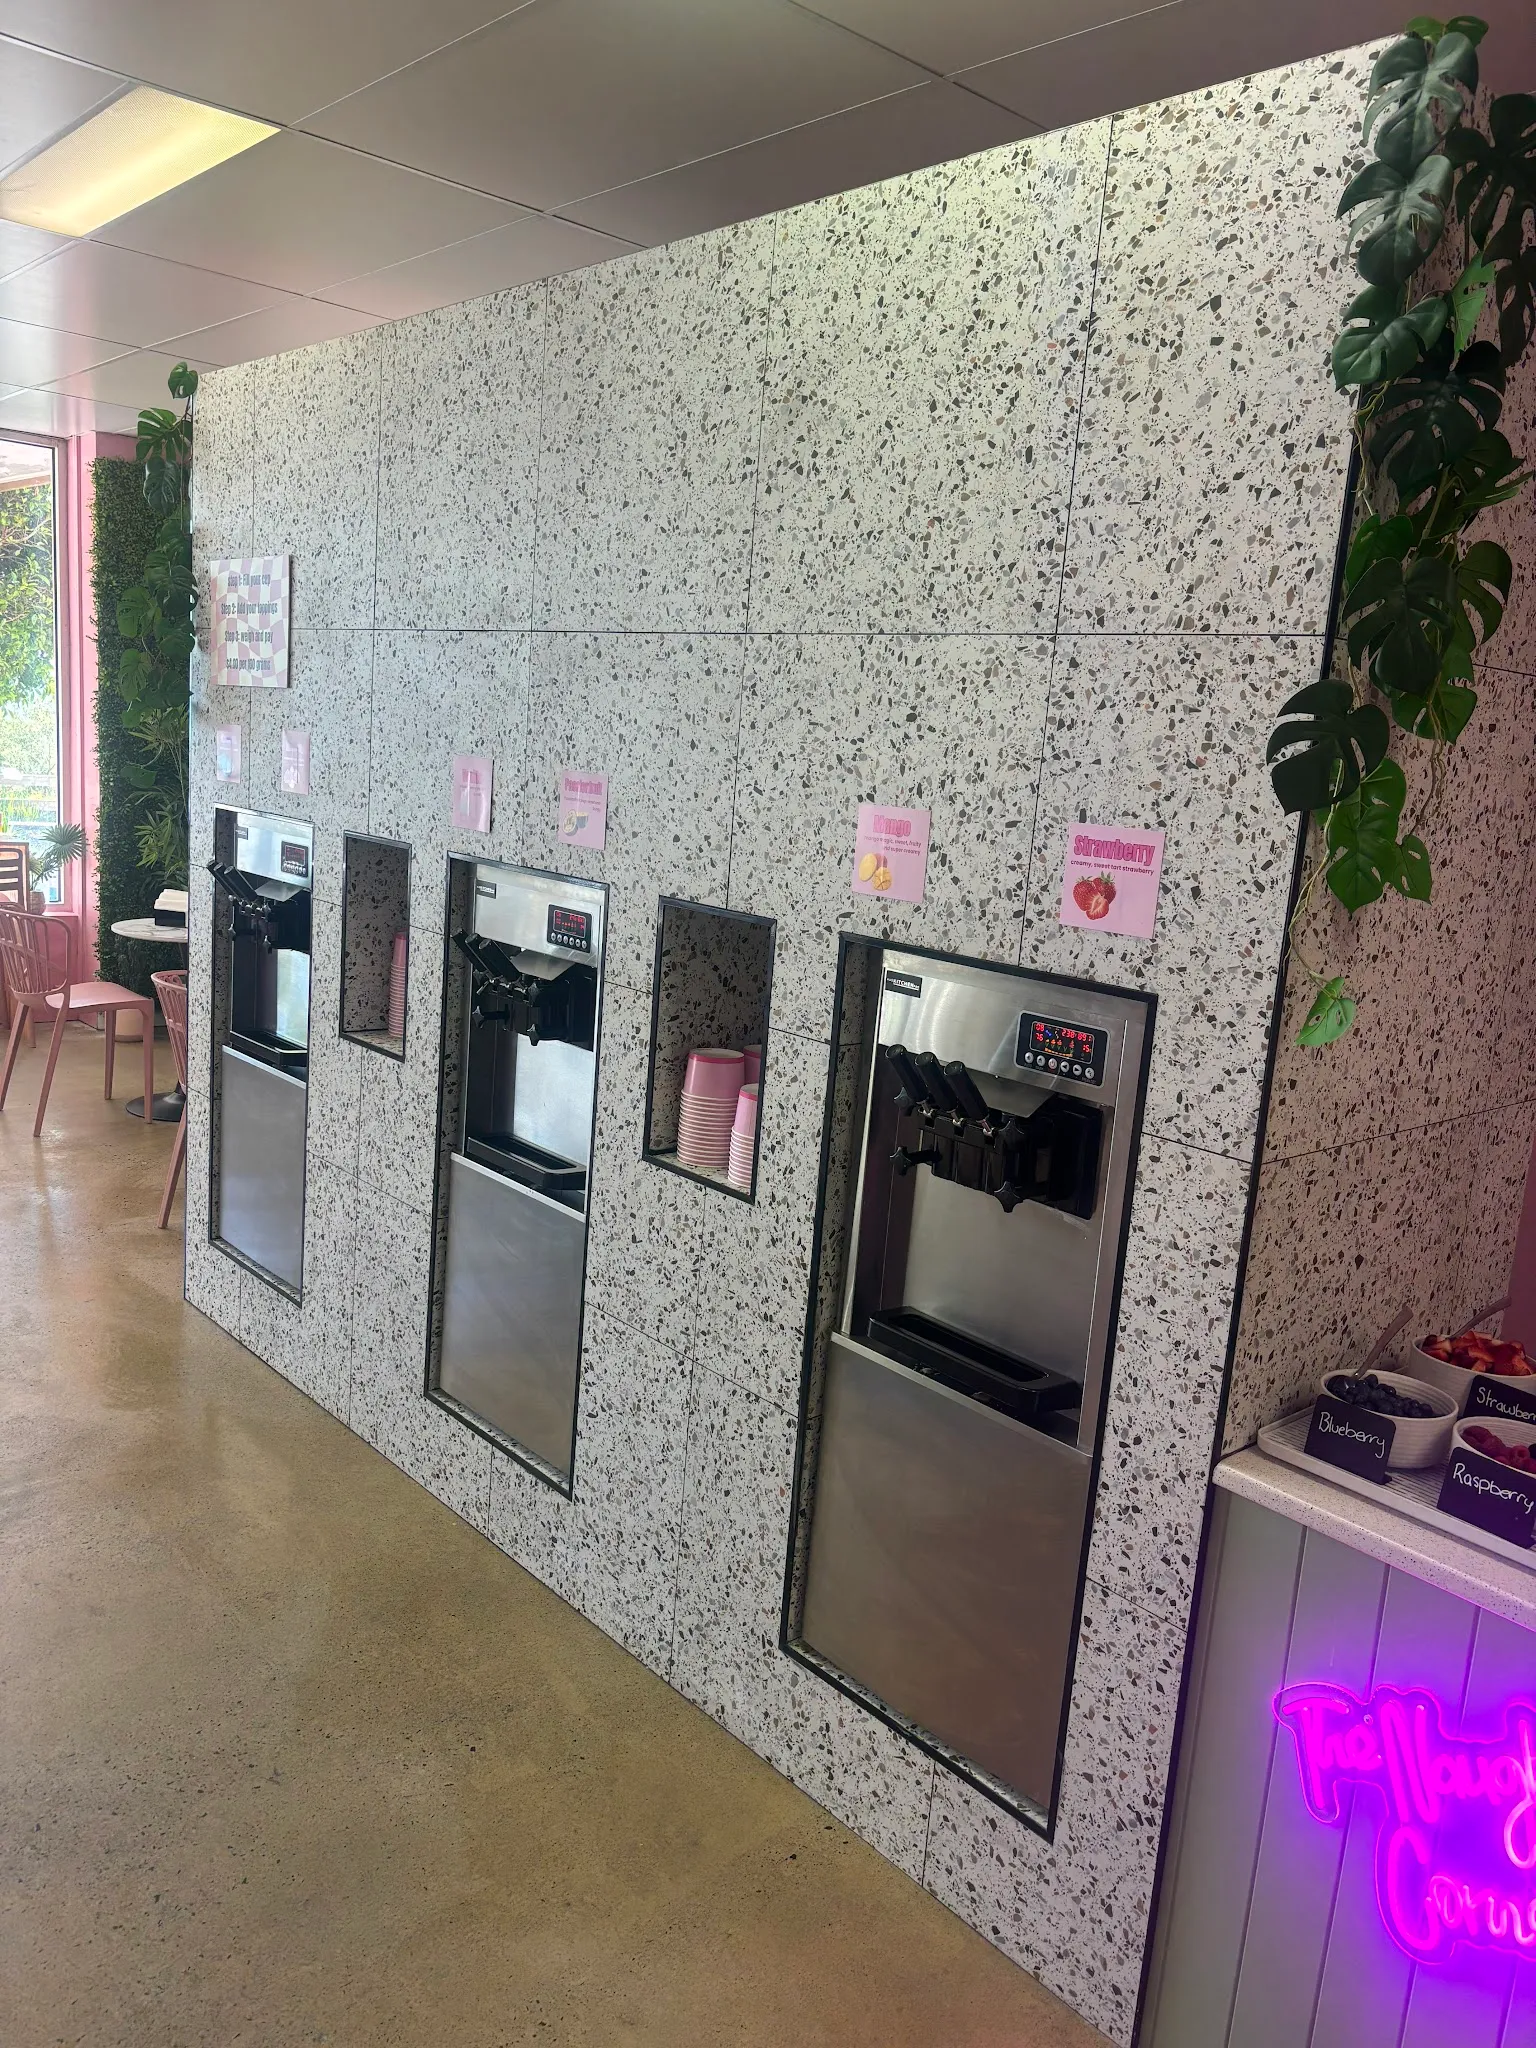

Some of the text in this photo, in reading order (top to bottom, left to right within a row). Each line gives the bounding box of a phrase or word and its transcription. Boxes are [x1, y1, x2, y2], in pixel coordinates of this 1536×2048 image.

[250, 574, 261, 587] your
[262, 573, 271, 587] cup
[221, 603, 231, 617] Step
[237, 602, 246, 614] Add
[246, 603, 257, 616] your
[257, 600, 278, 616] toppings
[225, 630, 235, 644] Step
[240, 631, 254, 643] weigh
[254, 630, 264, 642] and
[264, 630, 273, 644] pay
[239, 659, 247, 671] per
[247, 659, 255, 670] 100
[255, 659, 271, 671] grams
[873, 814, 911, 837] Mango
[1074, 834, 1155, 866] Strawberry
[1070, 859, 1094, 869] creamy,
[1122, 865, 1155, 876] strawberry
[1318, 1411, 1386, 1459] Blueberry
[1452, 1463, 1535, 1514] Raspberry
[1281, 1696, 1382, 1809] The
[1387, 1826, 1536, 1952] Corn
